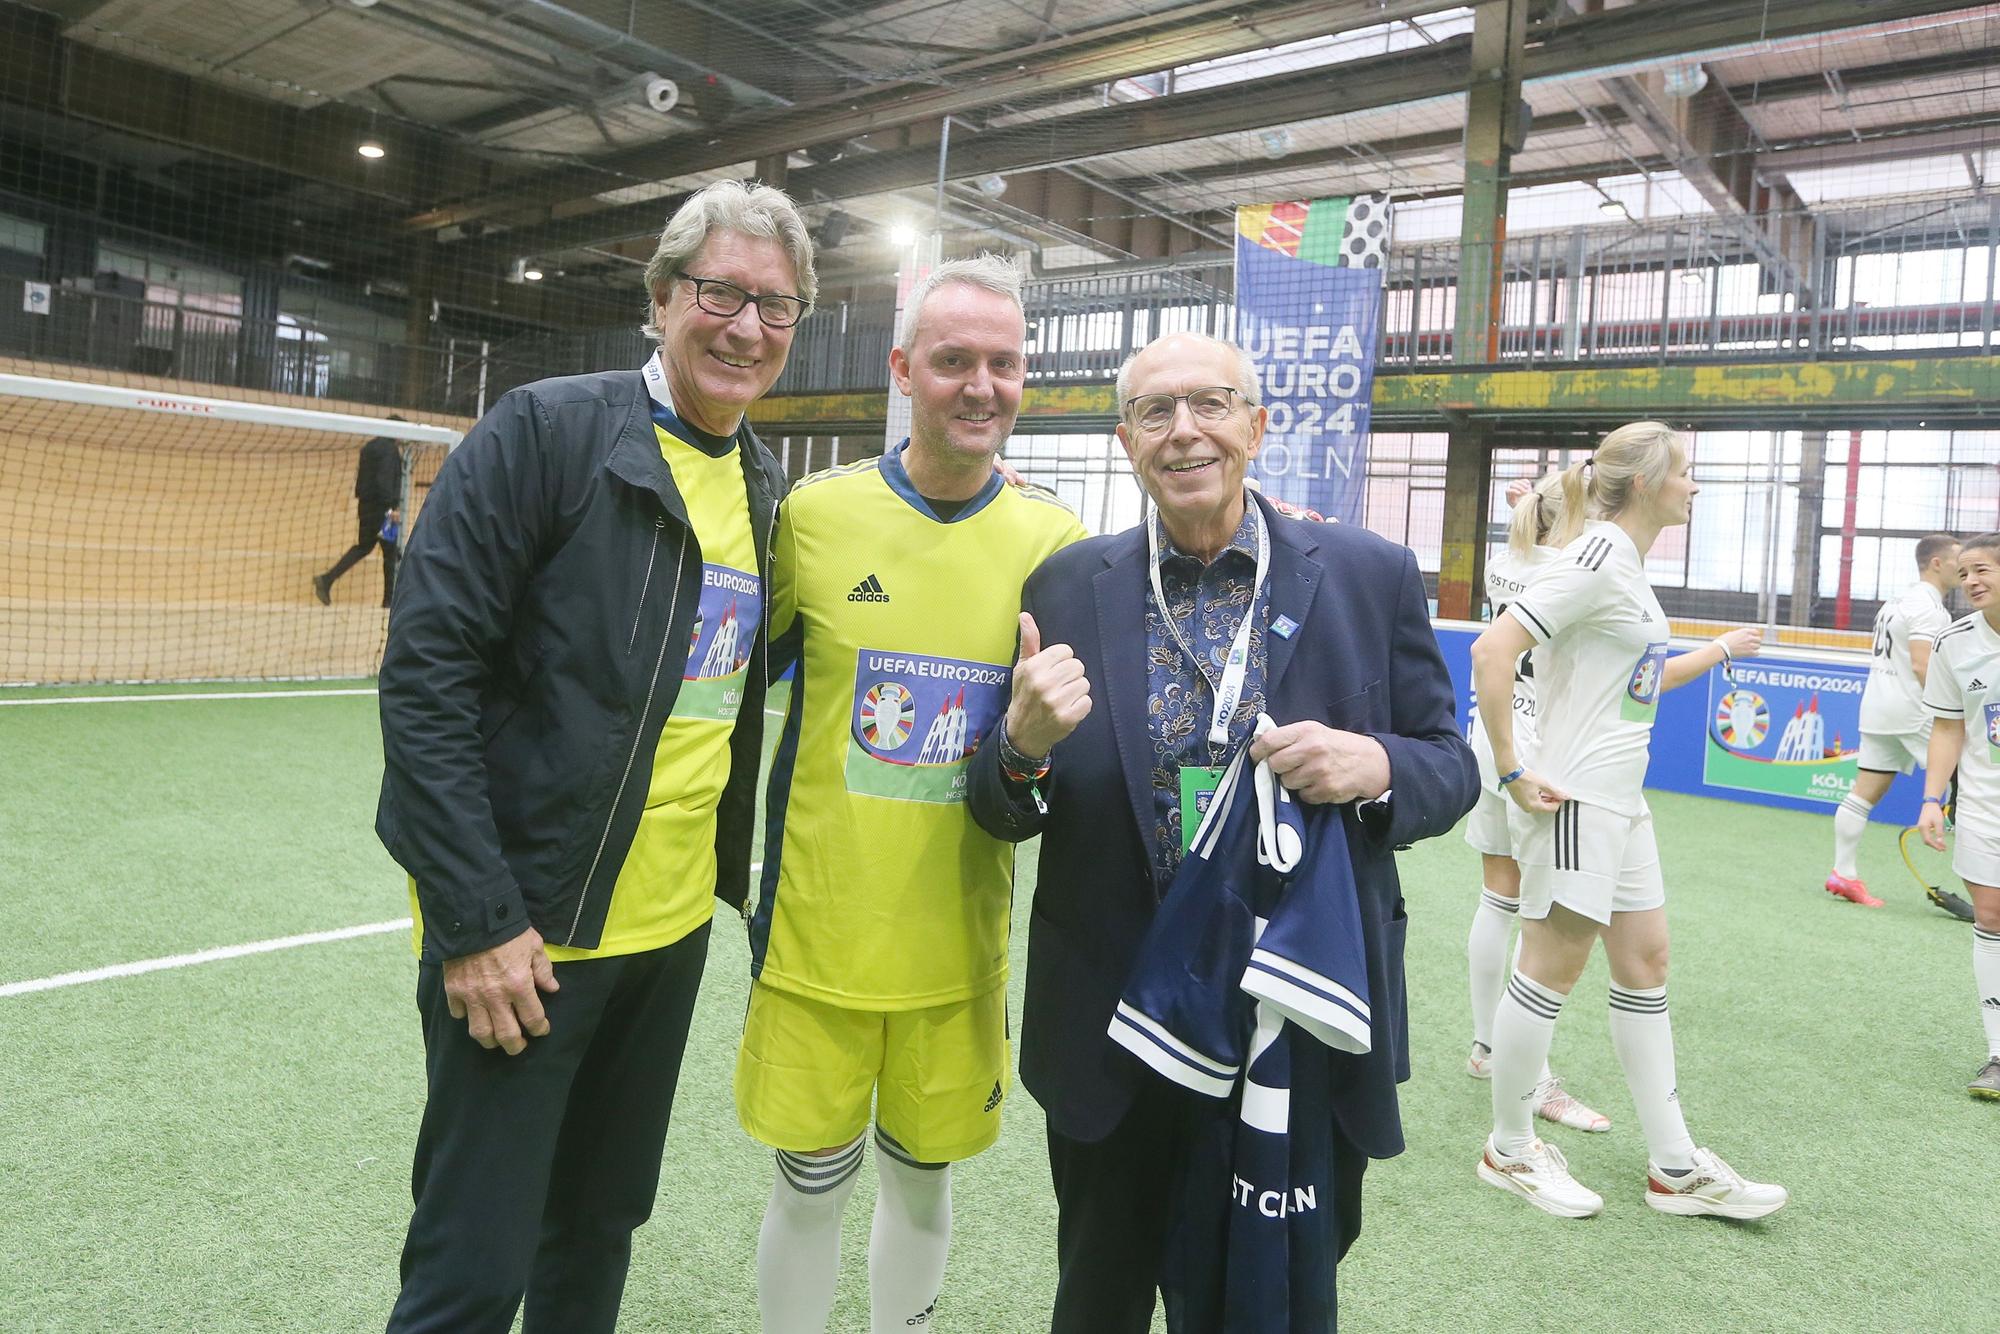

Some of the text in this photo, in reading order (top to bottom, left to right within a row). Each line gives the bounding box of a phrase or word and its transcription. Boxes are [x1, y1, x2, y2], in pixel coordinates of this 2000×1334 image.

[1243, 324, 1364, 361] UEFA
[1260, 436, 1354, 480] ÖLN
[703, 570, 758, 597] EURO2024
[847, 591, 890, 603] adidas
[1508, 581, 1527, 594] CIT
[1216, 685, 1236, 728] RO2024
[951, 771, 967, 789] KÖ
[1232, 1172, 1255, 1208] ST
